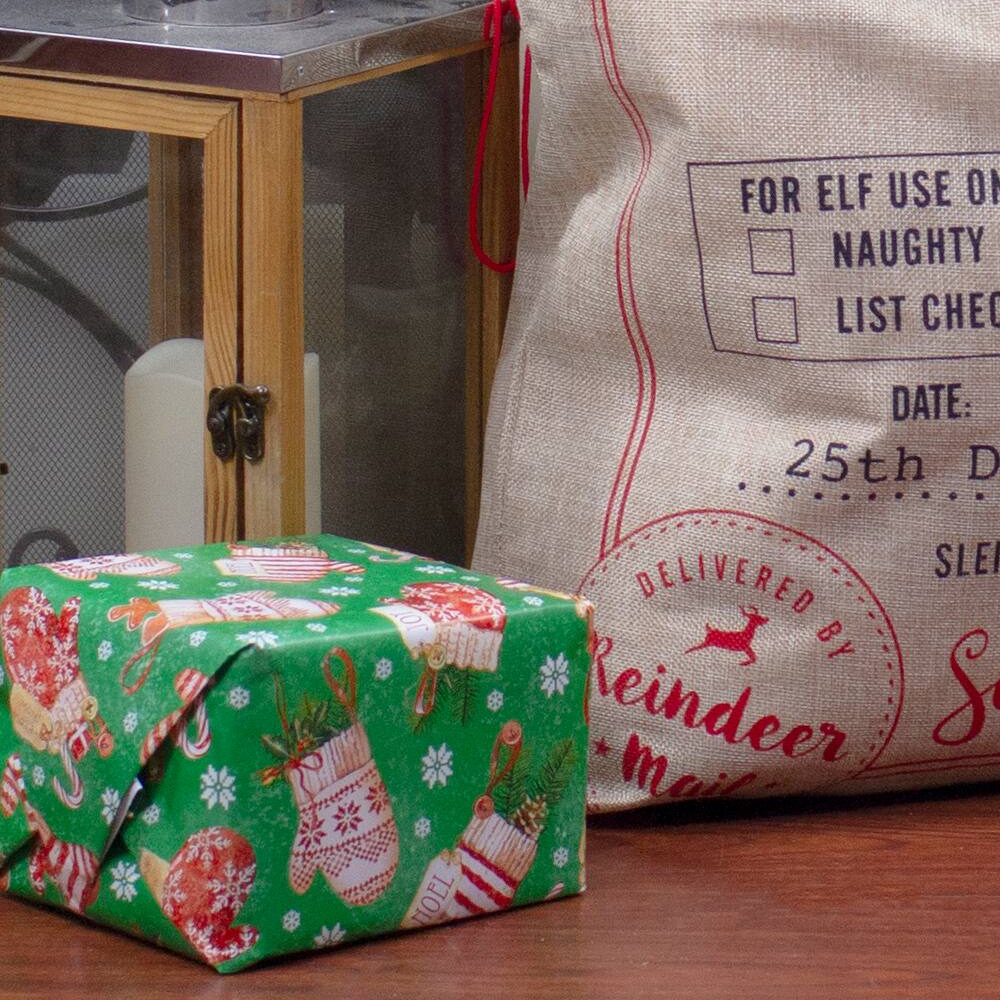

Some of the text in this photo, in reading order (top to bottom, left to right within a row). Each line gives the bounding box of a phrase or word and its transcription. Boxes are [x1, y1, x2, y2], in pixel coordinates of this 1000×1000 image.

[741, 177, 800, 214] FOR
[816, 174, 874, 212] ELF
[889, 170, 951, 206] USE
[832, 226, 985, 268] NAUGHTY
[836, 296, 906, 334] LIST
[891, 383, 972, 422] DATE:
[785, 438, 926, 483] 25th
[635, 551, 856, 660] DELIVERED BY
